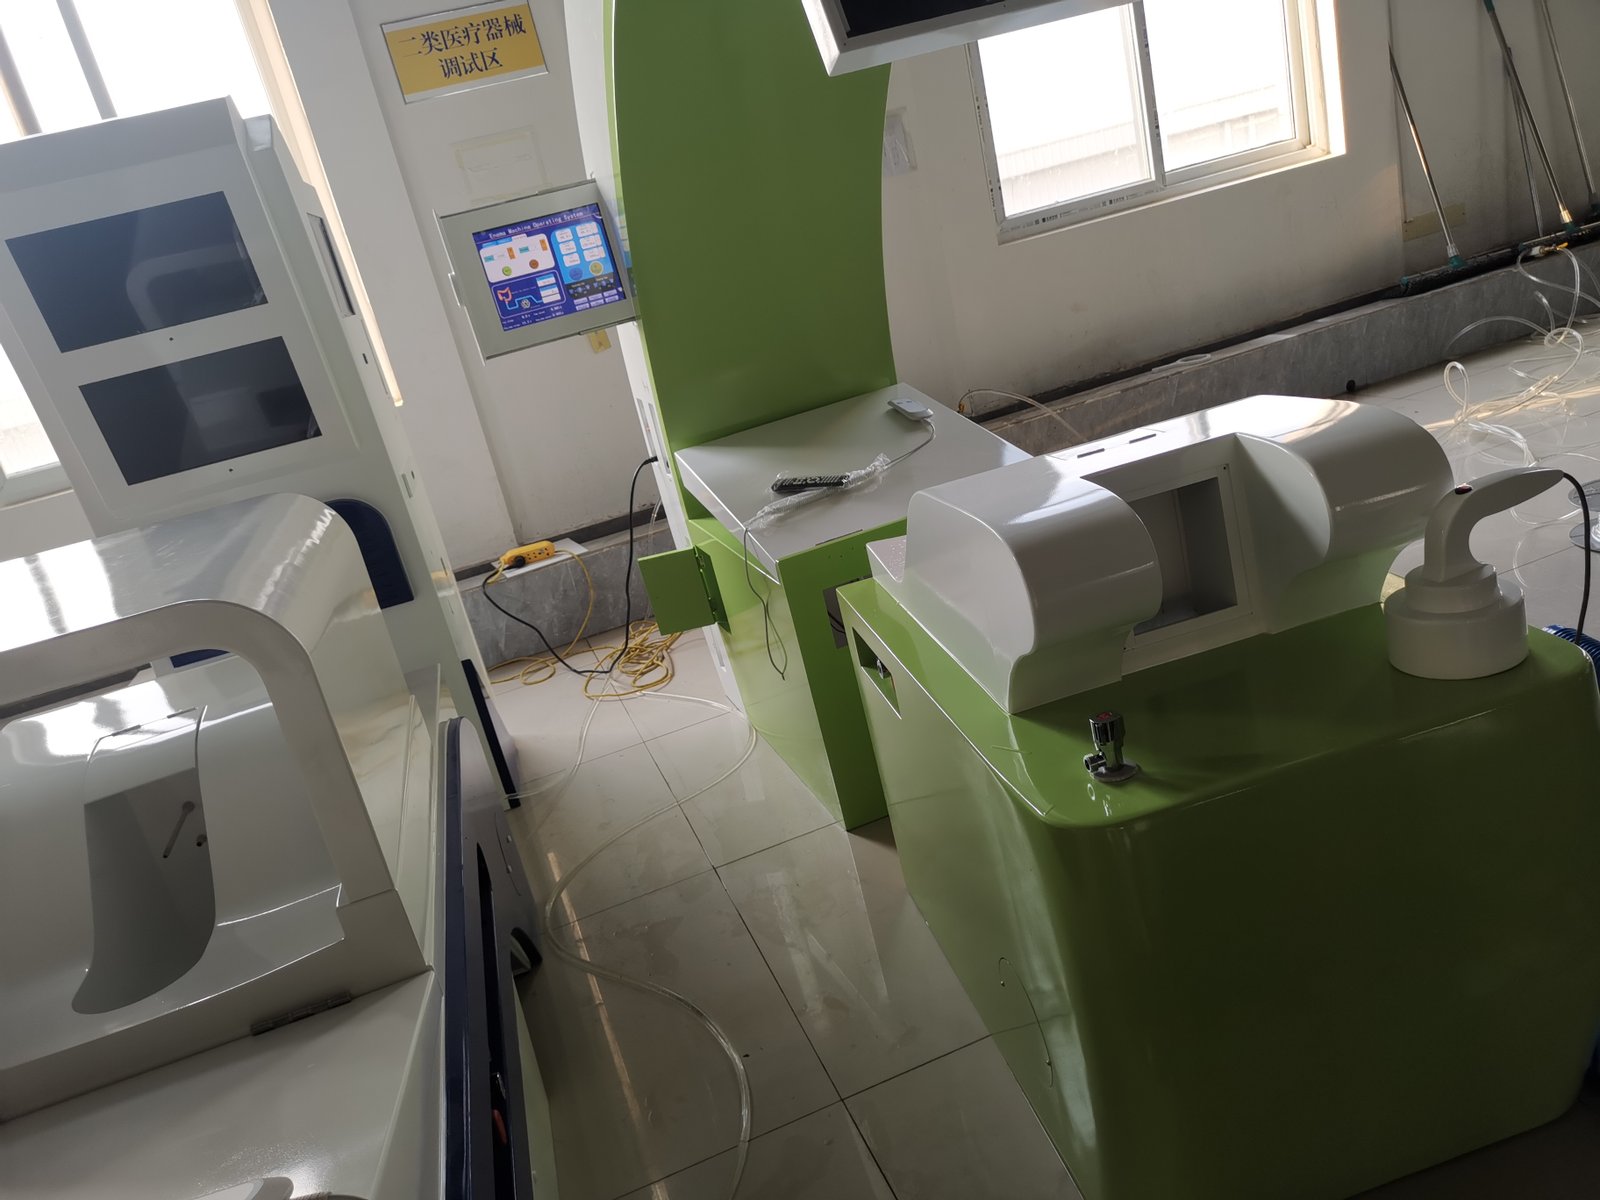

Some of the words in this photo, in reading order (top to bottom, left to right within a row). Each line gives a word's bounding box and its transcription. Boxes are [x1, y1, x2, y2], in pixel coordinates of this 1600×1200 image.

[398, 13, 527, 58] 二类医疗器械
[438, 47, 503, 79] 调试区
[489, 231, 506, 240] Enema
[507, 225, 531, 234] Machine
[532, 217, 562, 229] Operating
[563, 211, 584, 221] System
